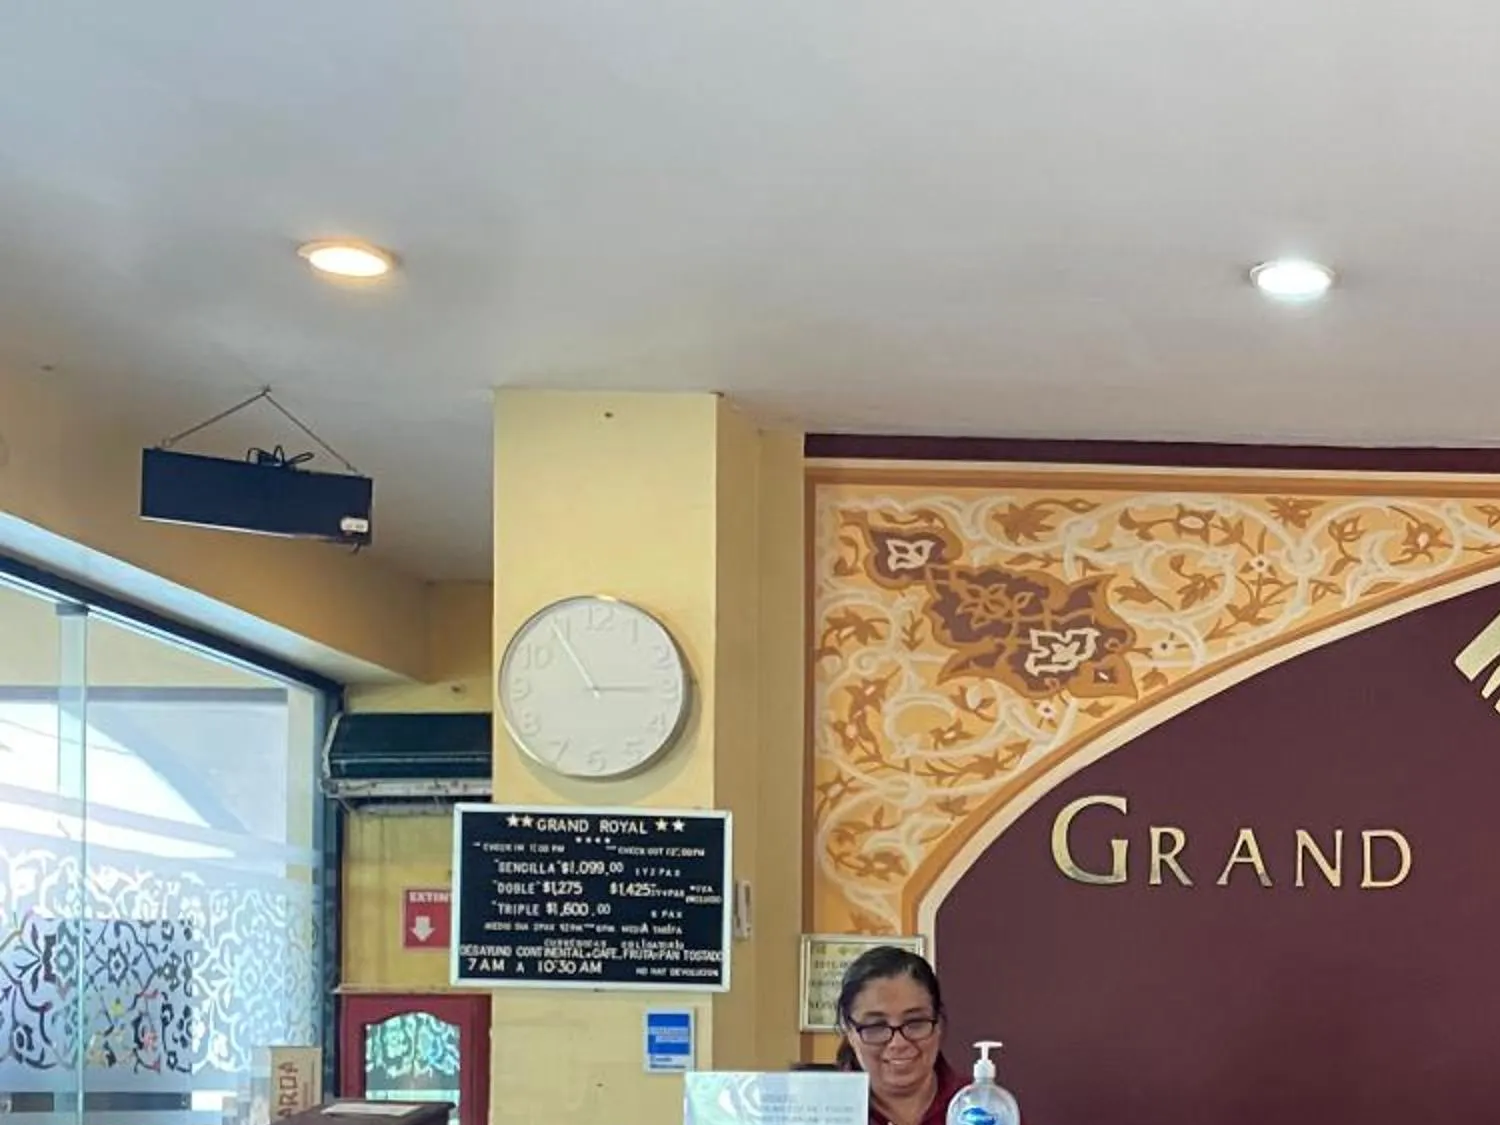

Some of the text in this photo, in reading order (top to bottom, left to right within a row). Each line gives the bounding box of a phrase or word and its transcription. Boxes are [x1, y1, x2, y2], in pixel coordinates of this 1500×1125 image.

[587, 605, 614, 631] 12
[537, 817, 648, 835] GRAND ROYAL
[1051, 795, 1413, 889] GRAND
[516, 961, 525, 973] A
